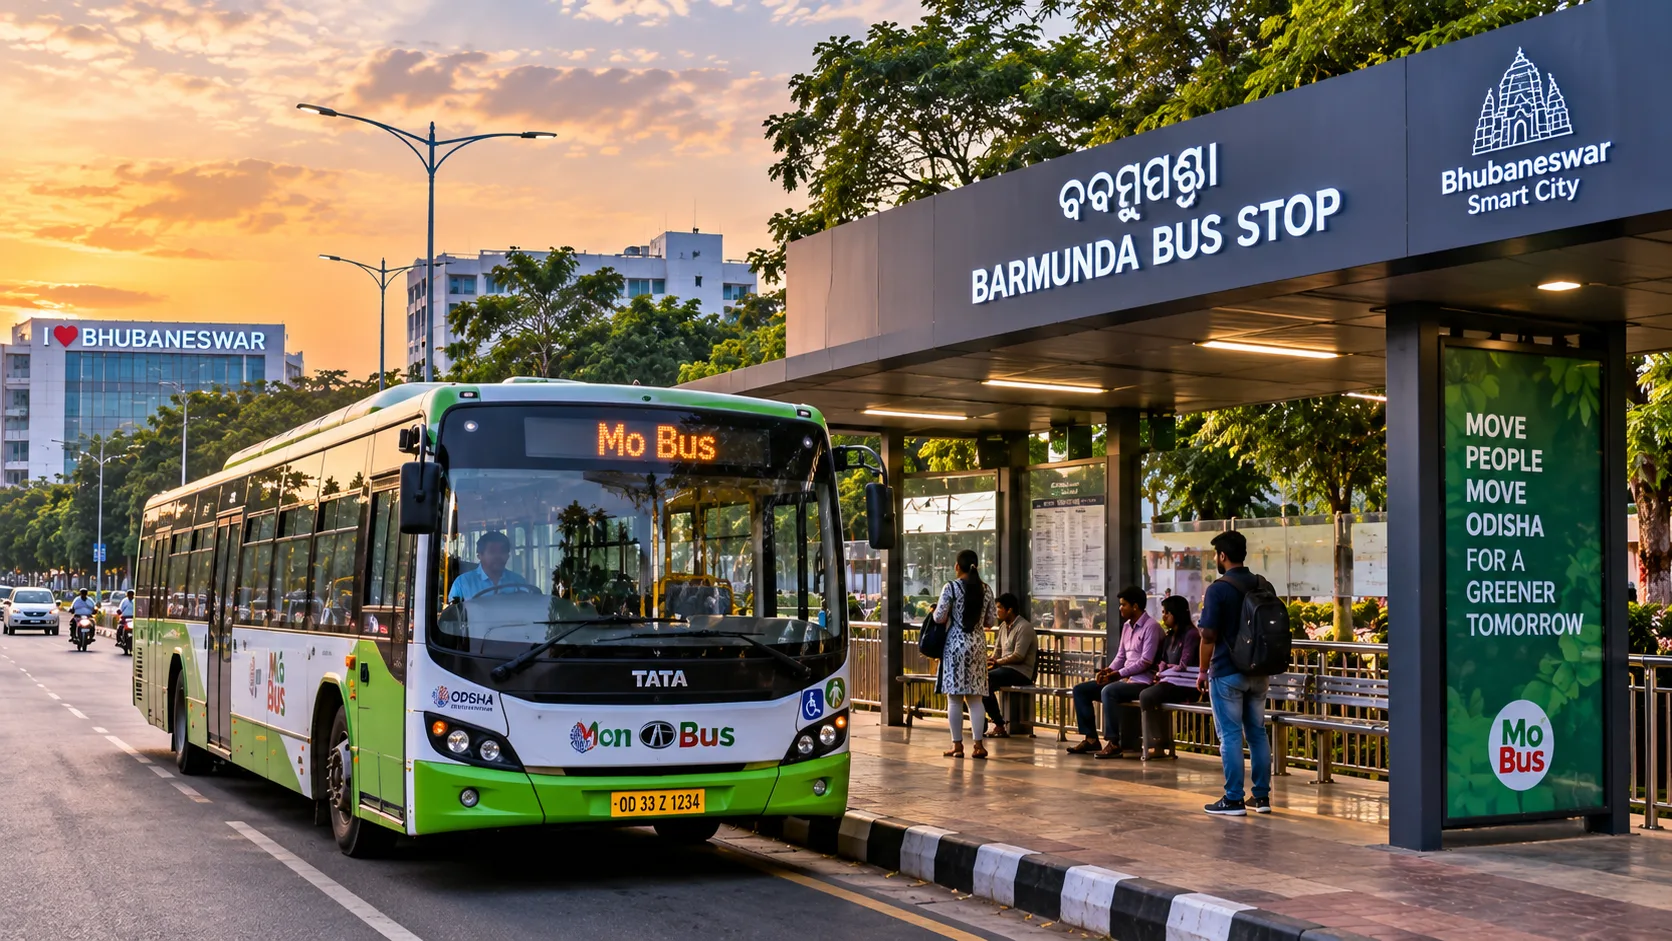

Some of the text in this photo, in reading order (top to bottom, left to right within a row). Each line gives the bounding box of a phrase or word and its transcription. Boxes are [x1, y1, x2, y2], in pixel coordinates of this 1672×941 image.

[1442, 141, 1611, 195] Bhubaneswar
[1468, 177, 1580, 215] Smart City
[972, 187, 1341, 304] BARMUNDA BUS STOP
[43, 327, 265, 351] I BHUBANESWAR
[1466, 412, 1527, 440] MOVE
[598, 422, 716, 460] Mo Bus
[1466, 446, 1543, 473] PEOPLE
[1466, 478, 1527, 505] MOVE
[1466, 512, 1545, 538] ODISHA
[1466, 548, 1526, 572] FOR A
[1466, 580, 1556, 604] GREENER
[1466, 612, 1585, 637] TOMORROW
[632, 670, 688, 687] TATA
[679, 721, 736, 748] Bus
[1501, 718, 1543, 748] Mo
[1499, 746, 1545, 774] Bus
[619, 793, 700, 812] OD 33 Z 1234
